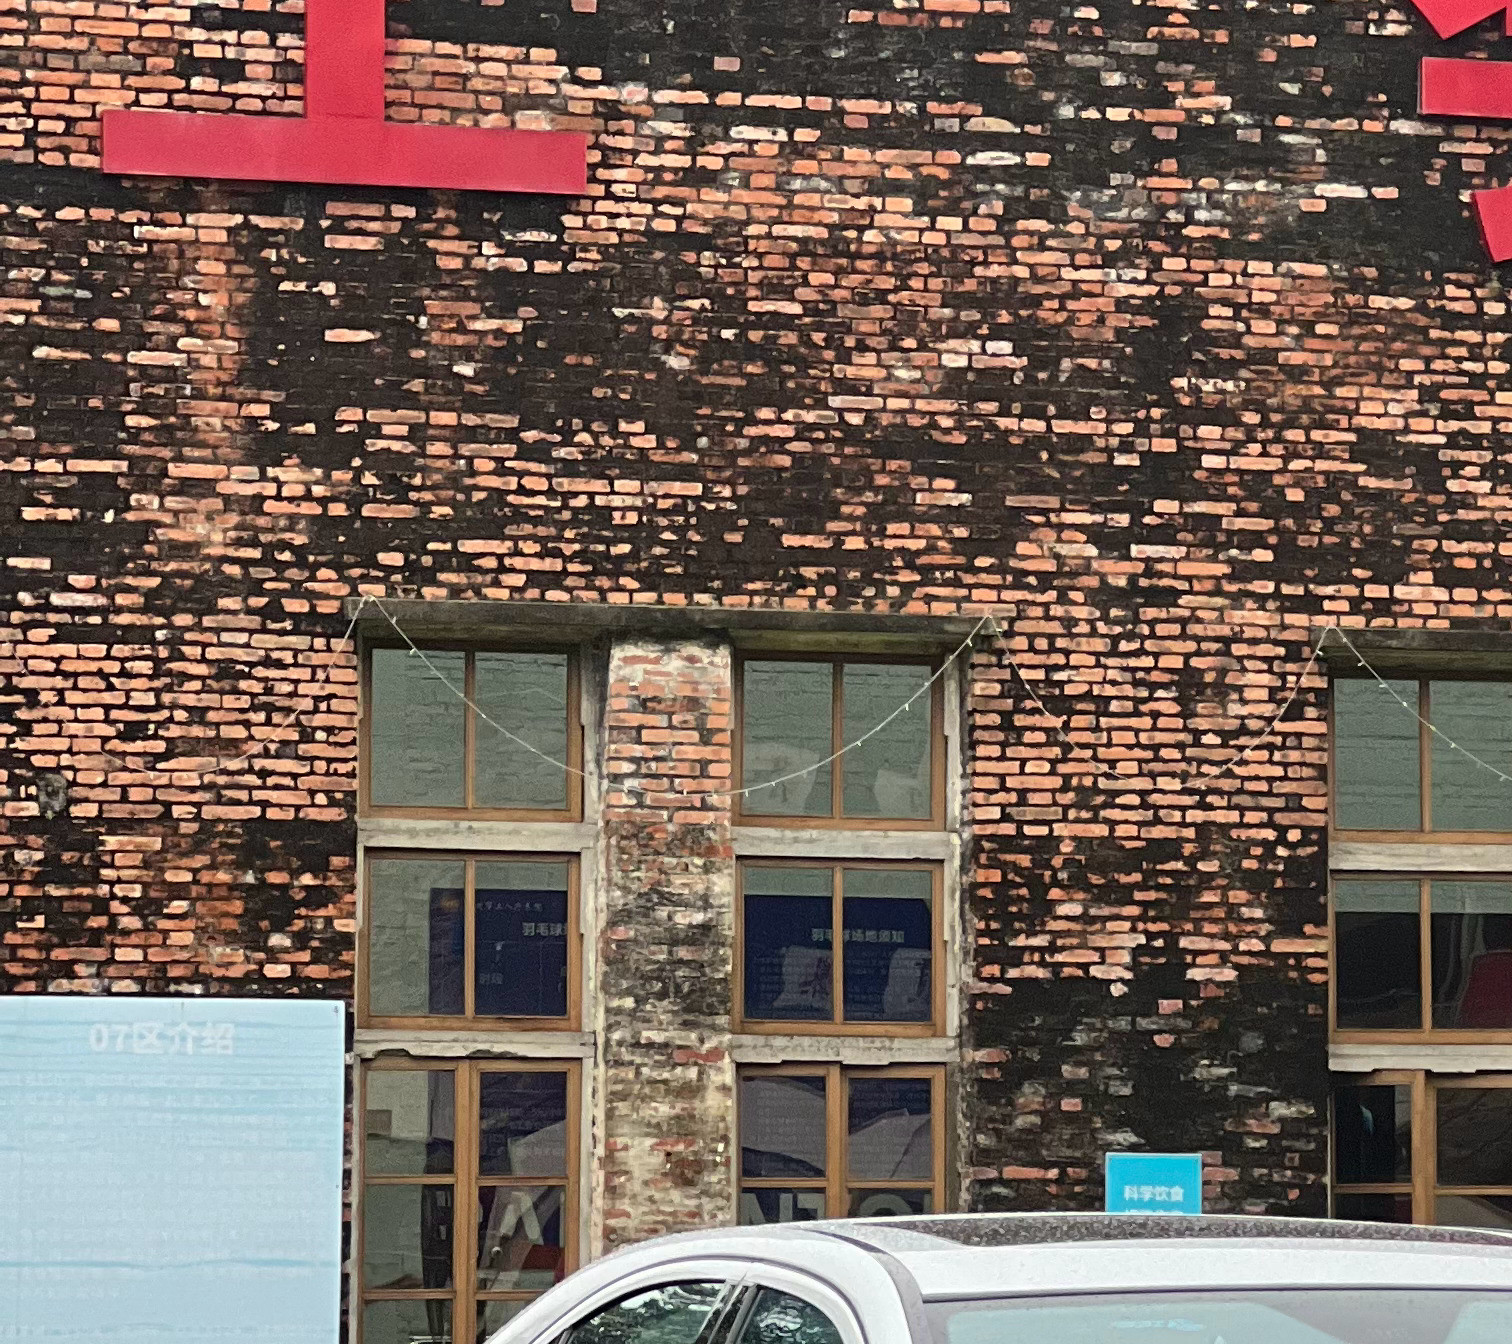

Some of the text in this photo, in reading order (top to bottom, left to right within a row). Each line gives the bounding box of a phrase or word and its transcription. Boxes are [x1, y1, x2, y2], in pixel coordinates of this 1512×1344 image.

[522, 922, 567, 936] 羽毛球
[89, 1022, 237, 1055] 07区介绍
